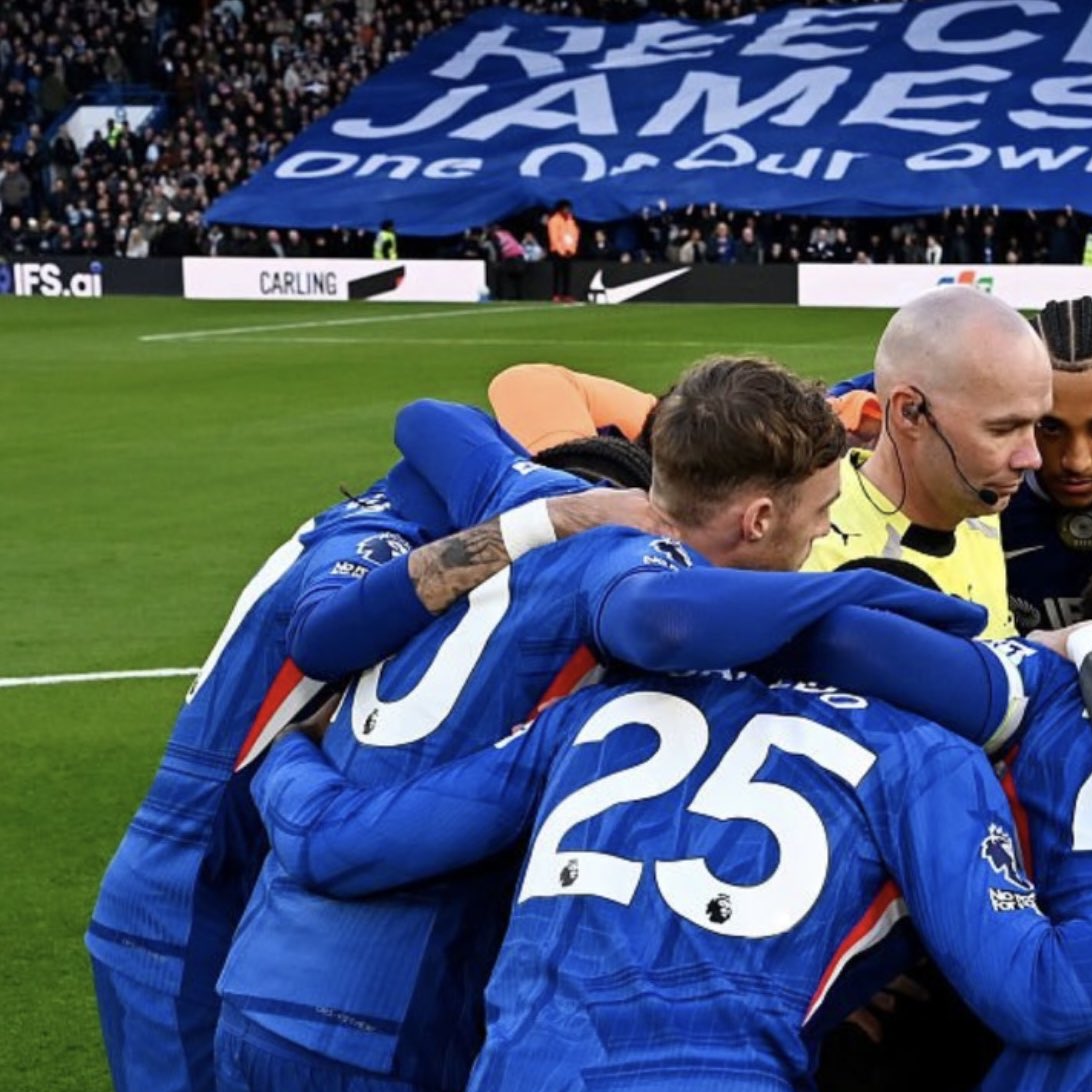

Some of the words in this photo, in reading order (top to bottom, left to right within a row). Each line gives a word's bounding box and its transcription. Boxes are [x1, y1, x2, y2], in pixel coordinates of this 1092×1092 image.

[673, 133, 871, 181] Our
[13, 260, 104, 297] IFS.ai
[260, 271, 337, 295] CARLING
[516, 691, 878, 939] 25
